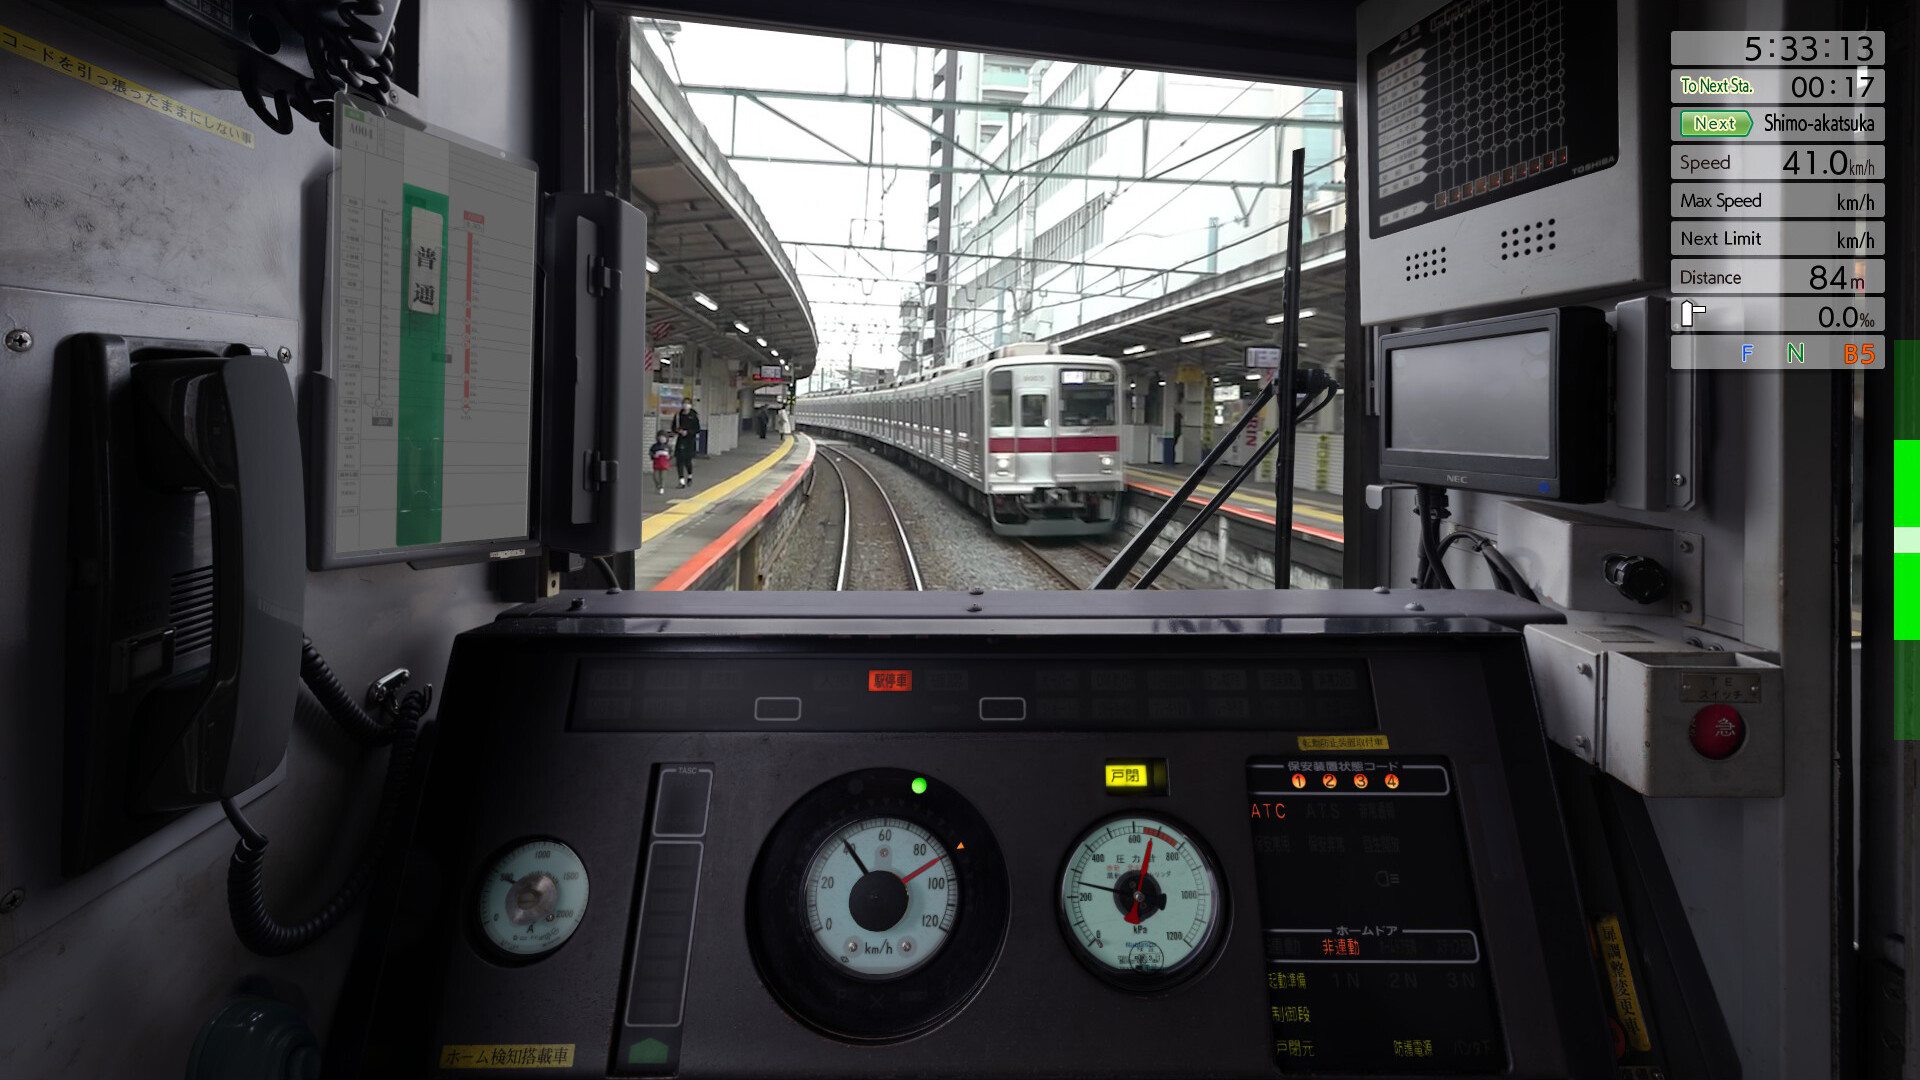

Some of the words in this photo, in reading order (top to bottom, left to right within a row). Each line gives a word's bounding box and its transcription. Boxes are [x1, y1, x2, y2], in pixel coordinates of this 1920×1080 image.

[2, 31, 252, 145] コードを引っ張ったままにしない事
[1571, 155, 1615, 175] TOSHIBA
[413, 246, 437, 307] 普通
[1446, 474, 1468, 484] NEC
[874, 673, 907, 689] 駅停車
[1699, 690, 1743, 700] スイッチ
[1714, 717, 1736, 737] 急
[1288, 761, 1399, 772] 保安装置状態コード
[1111, 768, 1140, 783] 戸閉
[1251, 803, 1286, 819] ATC
[878, 829, 892, 841] 60
[1128, 834, 1141, 844] 600
[913, 843, 927, 856] 80
[1091, 853, 1105, 863] 400
[1165, 851, 1179, 862] 800
[821, 876, 834, 889] 20
[928, 877, 945, 890] 100
[1079, 892, 1093, 902] 200
[1181, 890, 1197, 900] 1000
[825, 917, 833, 931] 0
[921, 914, 939, 928] 120
[1133, 925, 1148, 935] kPa
[1166, 931, 1183, 941] 1200
[1336, 926, 1398, 937] ホームドア
[864, 939, 893, 955] km/h
[1322, 938, 1360, 955] 非連動
[1272, 1006, 1312, 1023] 制御段
[1276, 1040, 1315, 1057] 戸閉元
[1394, 1040, 1433, 1057] 防護電源
[446, 1047, 569, 1066] ホーム検知搭載車
